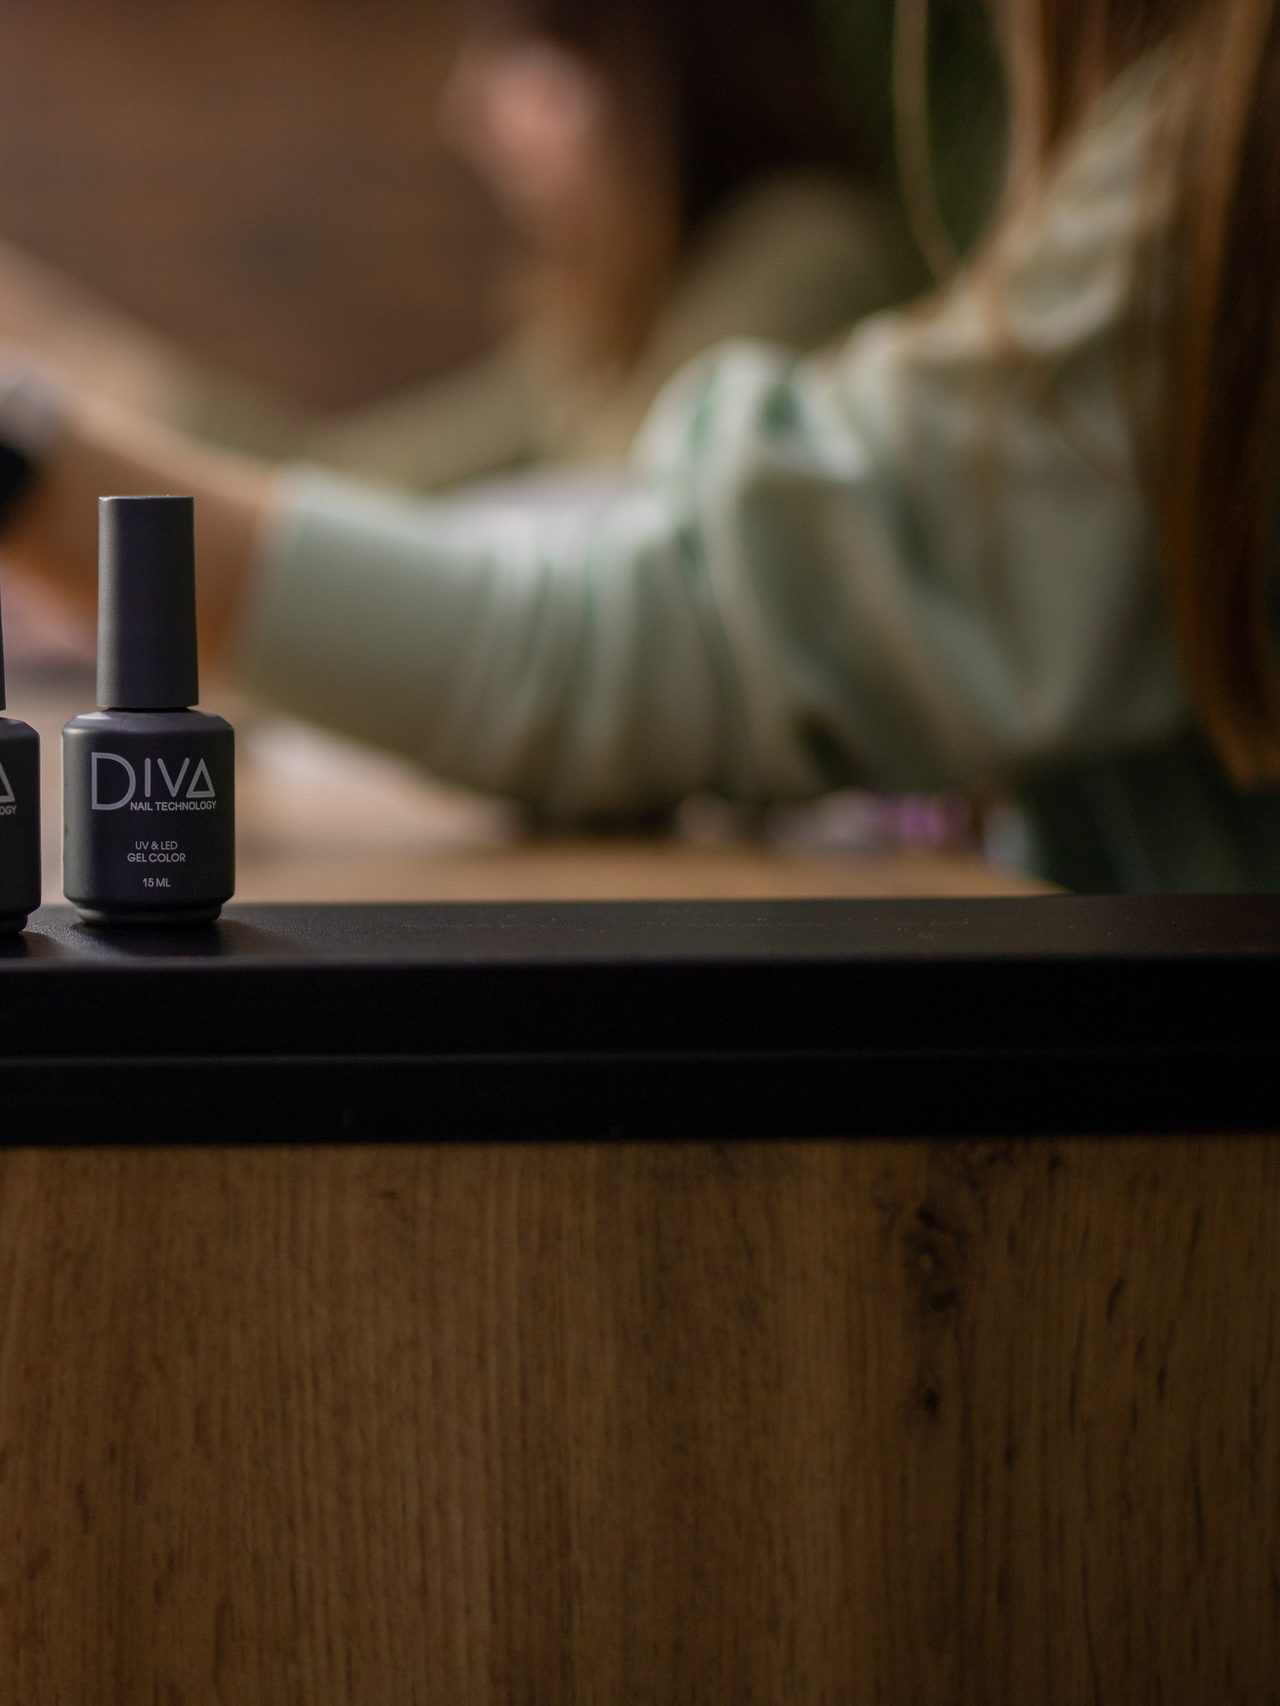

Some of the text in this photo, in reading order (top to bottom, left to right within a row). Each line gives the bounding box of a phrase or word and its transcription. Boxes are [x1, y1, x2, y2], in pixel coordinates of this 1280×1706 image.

[92, 752, 215, 810] DIVA
[130, 800, 216, 811] NAIL TECHNOLOGY
[135, 841, 178, 850] UV & LED
[127, 853, 186, 863] GEL COLOR
[142, 878, 170, 888] 15 ML
